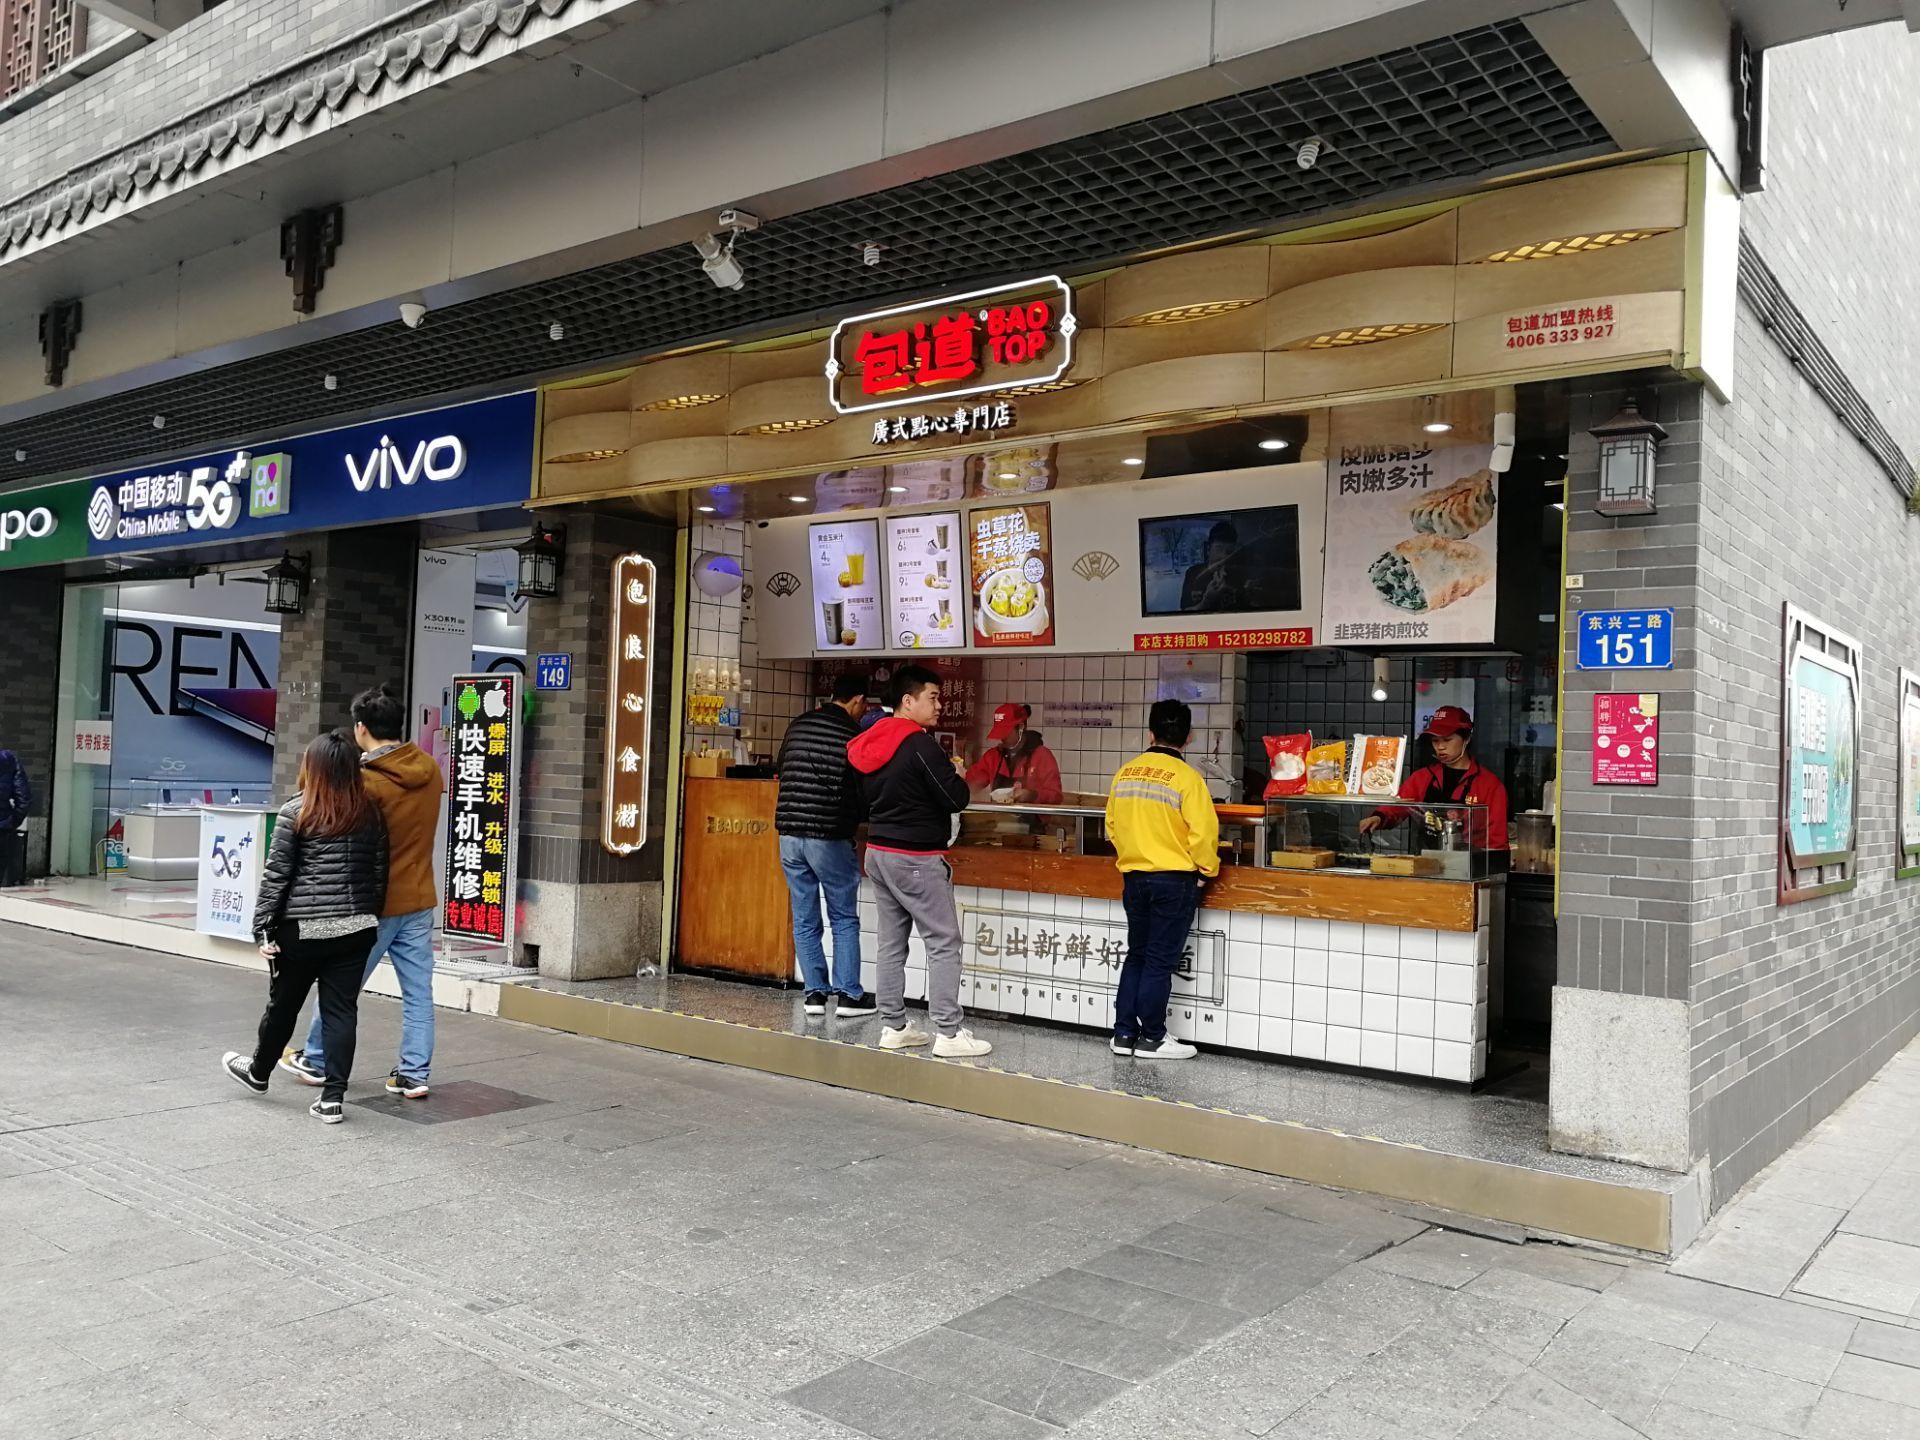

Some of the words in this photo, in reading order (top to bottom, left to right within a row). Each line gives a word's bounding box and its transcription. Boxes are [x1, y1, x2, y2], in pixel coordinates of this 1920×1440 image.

[986, 301, 1049, 337] BAO
[1507, 304, 1614, 333] 包道加盟热线
[988, 330, 1047, 364] TOP
[1506, 332, 1545, 349] 4006
[1549, 328, 1579, 344] 333
[1584, 324, 1614, 340] 927
[854, 311, 976, 395] 包道
[871, 401, 1011, 445] 廣式點心專門店
[344, 434, 464, 492] vivo
[118, 472, 184, 513] 中国移动
[1340, 463, 1434, 496] 肉嫩多汁
[117, 517, 146, 539] China
[147, 513, 181, 536] Mobile
[977, 511, 1024, 542] 虫草花
[424, 556, 448, 566] vivo
[977, 530, 1041, 560] 干蒸烧卖
[1334, 621, 1429, 641] 韭菜猪肉煎饺
[1588, 614, 1663, 631] 东兴二路
[1140, 634, 1209, 649] 本店支持团购
[1217, 630, 1307, 646] 15218298782
[1595, 633, 1654, 665] 151
[542, 667, 565, 687] 149
[75, 733, 111, 751] 宽带报装
[487, 722, 507, 757] 爆屏
[486, 772, 505, 805] 进水
[452, 723, 487, 900] 快速手机维修
[484, 821, 503, 855] 升级
[212, 887, 243, 912] 看移动
[481, 870, 502, 904] 解锁
[448, 900, 503, 935] 专业诚信
[960, 978, 1094, 1006] CANTONESE
